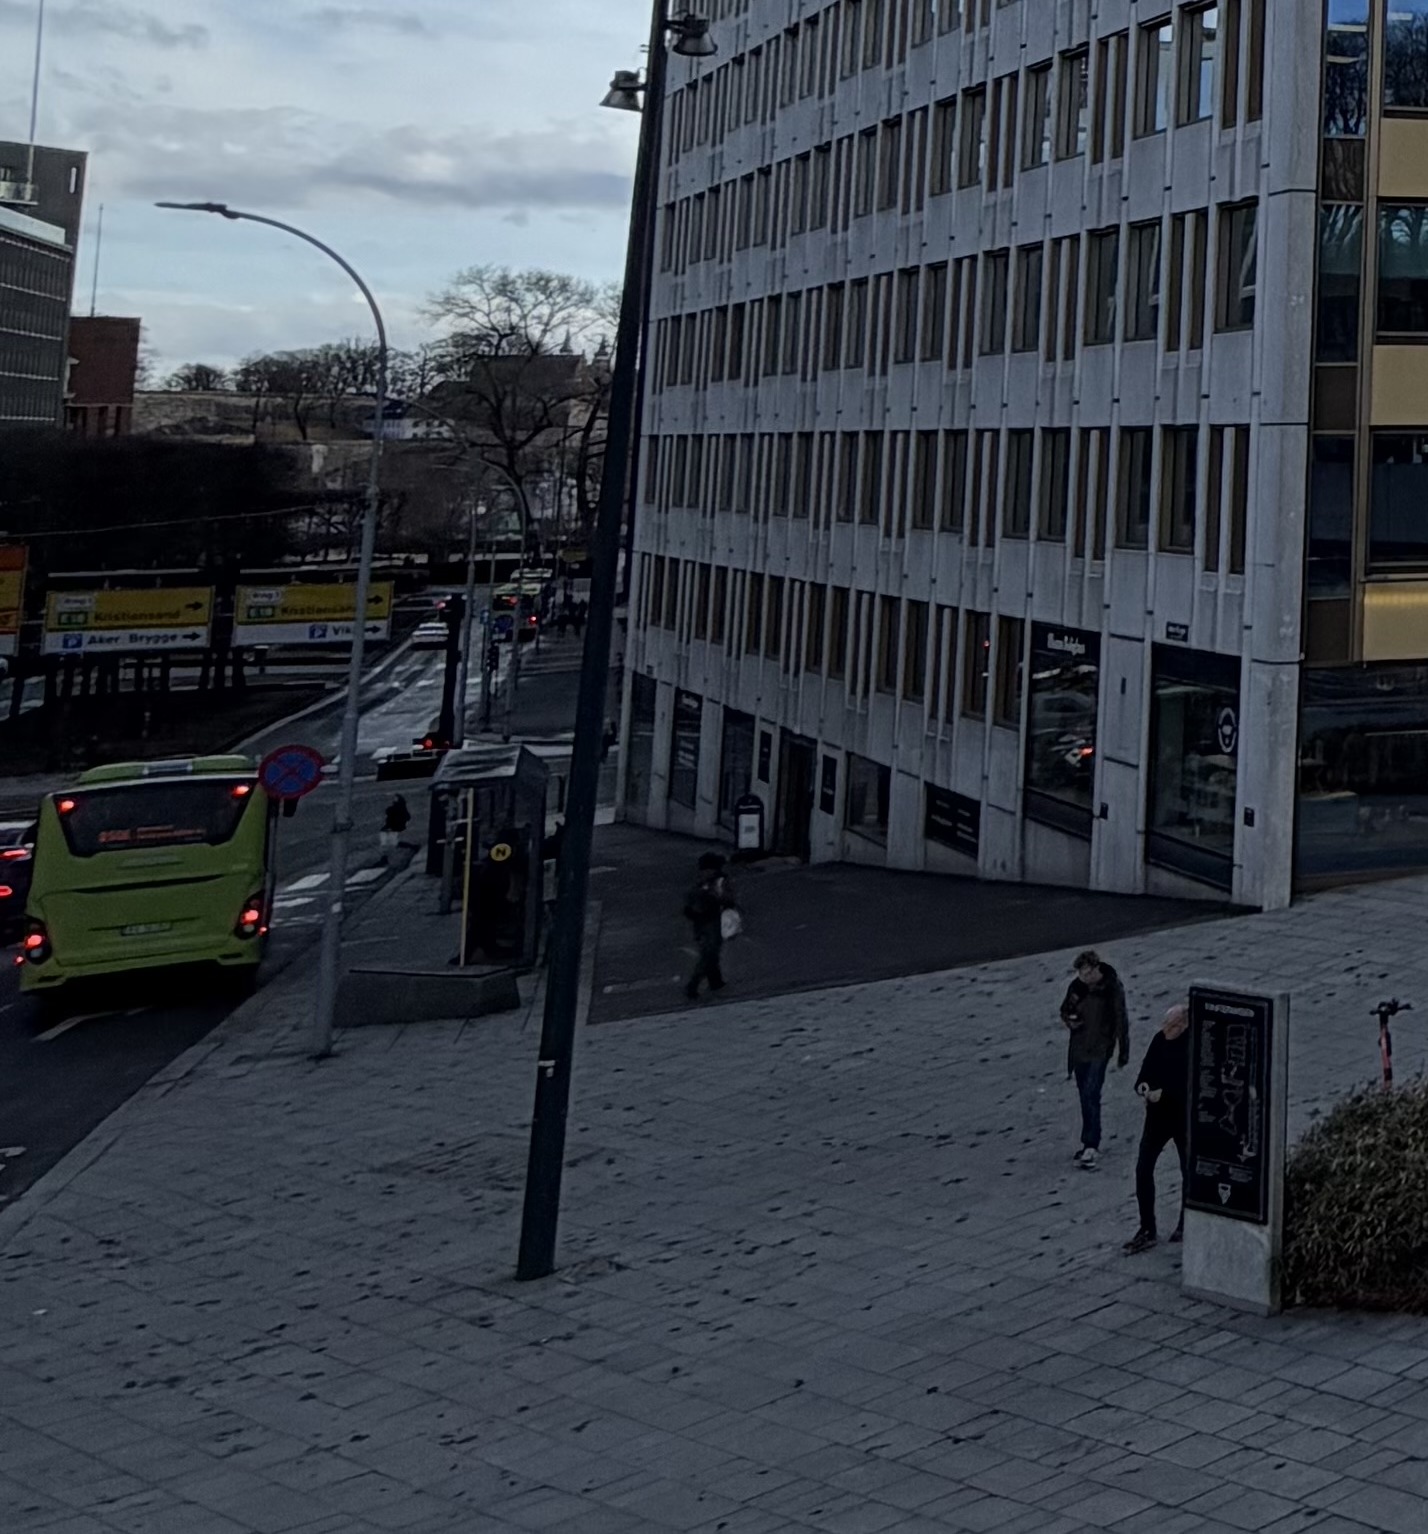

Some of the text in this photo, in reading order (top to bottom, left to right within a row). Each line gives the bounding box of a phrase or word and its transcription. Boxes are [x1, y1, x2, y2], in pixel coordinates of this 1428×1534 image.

[281, 605, 357, 617] Kristiansan
[333, 626, 354, 637] Vik
[129, 633, 178, 646] Brygge
